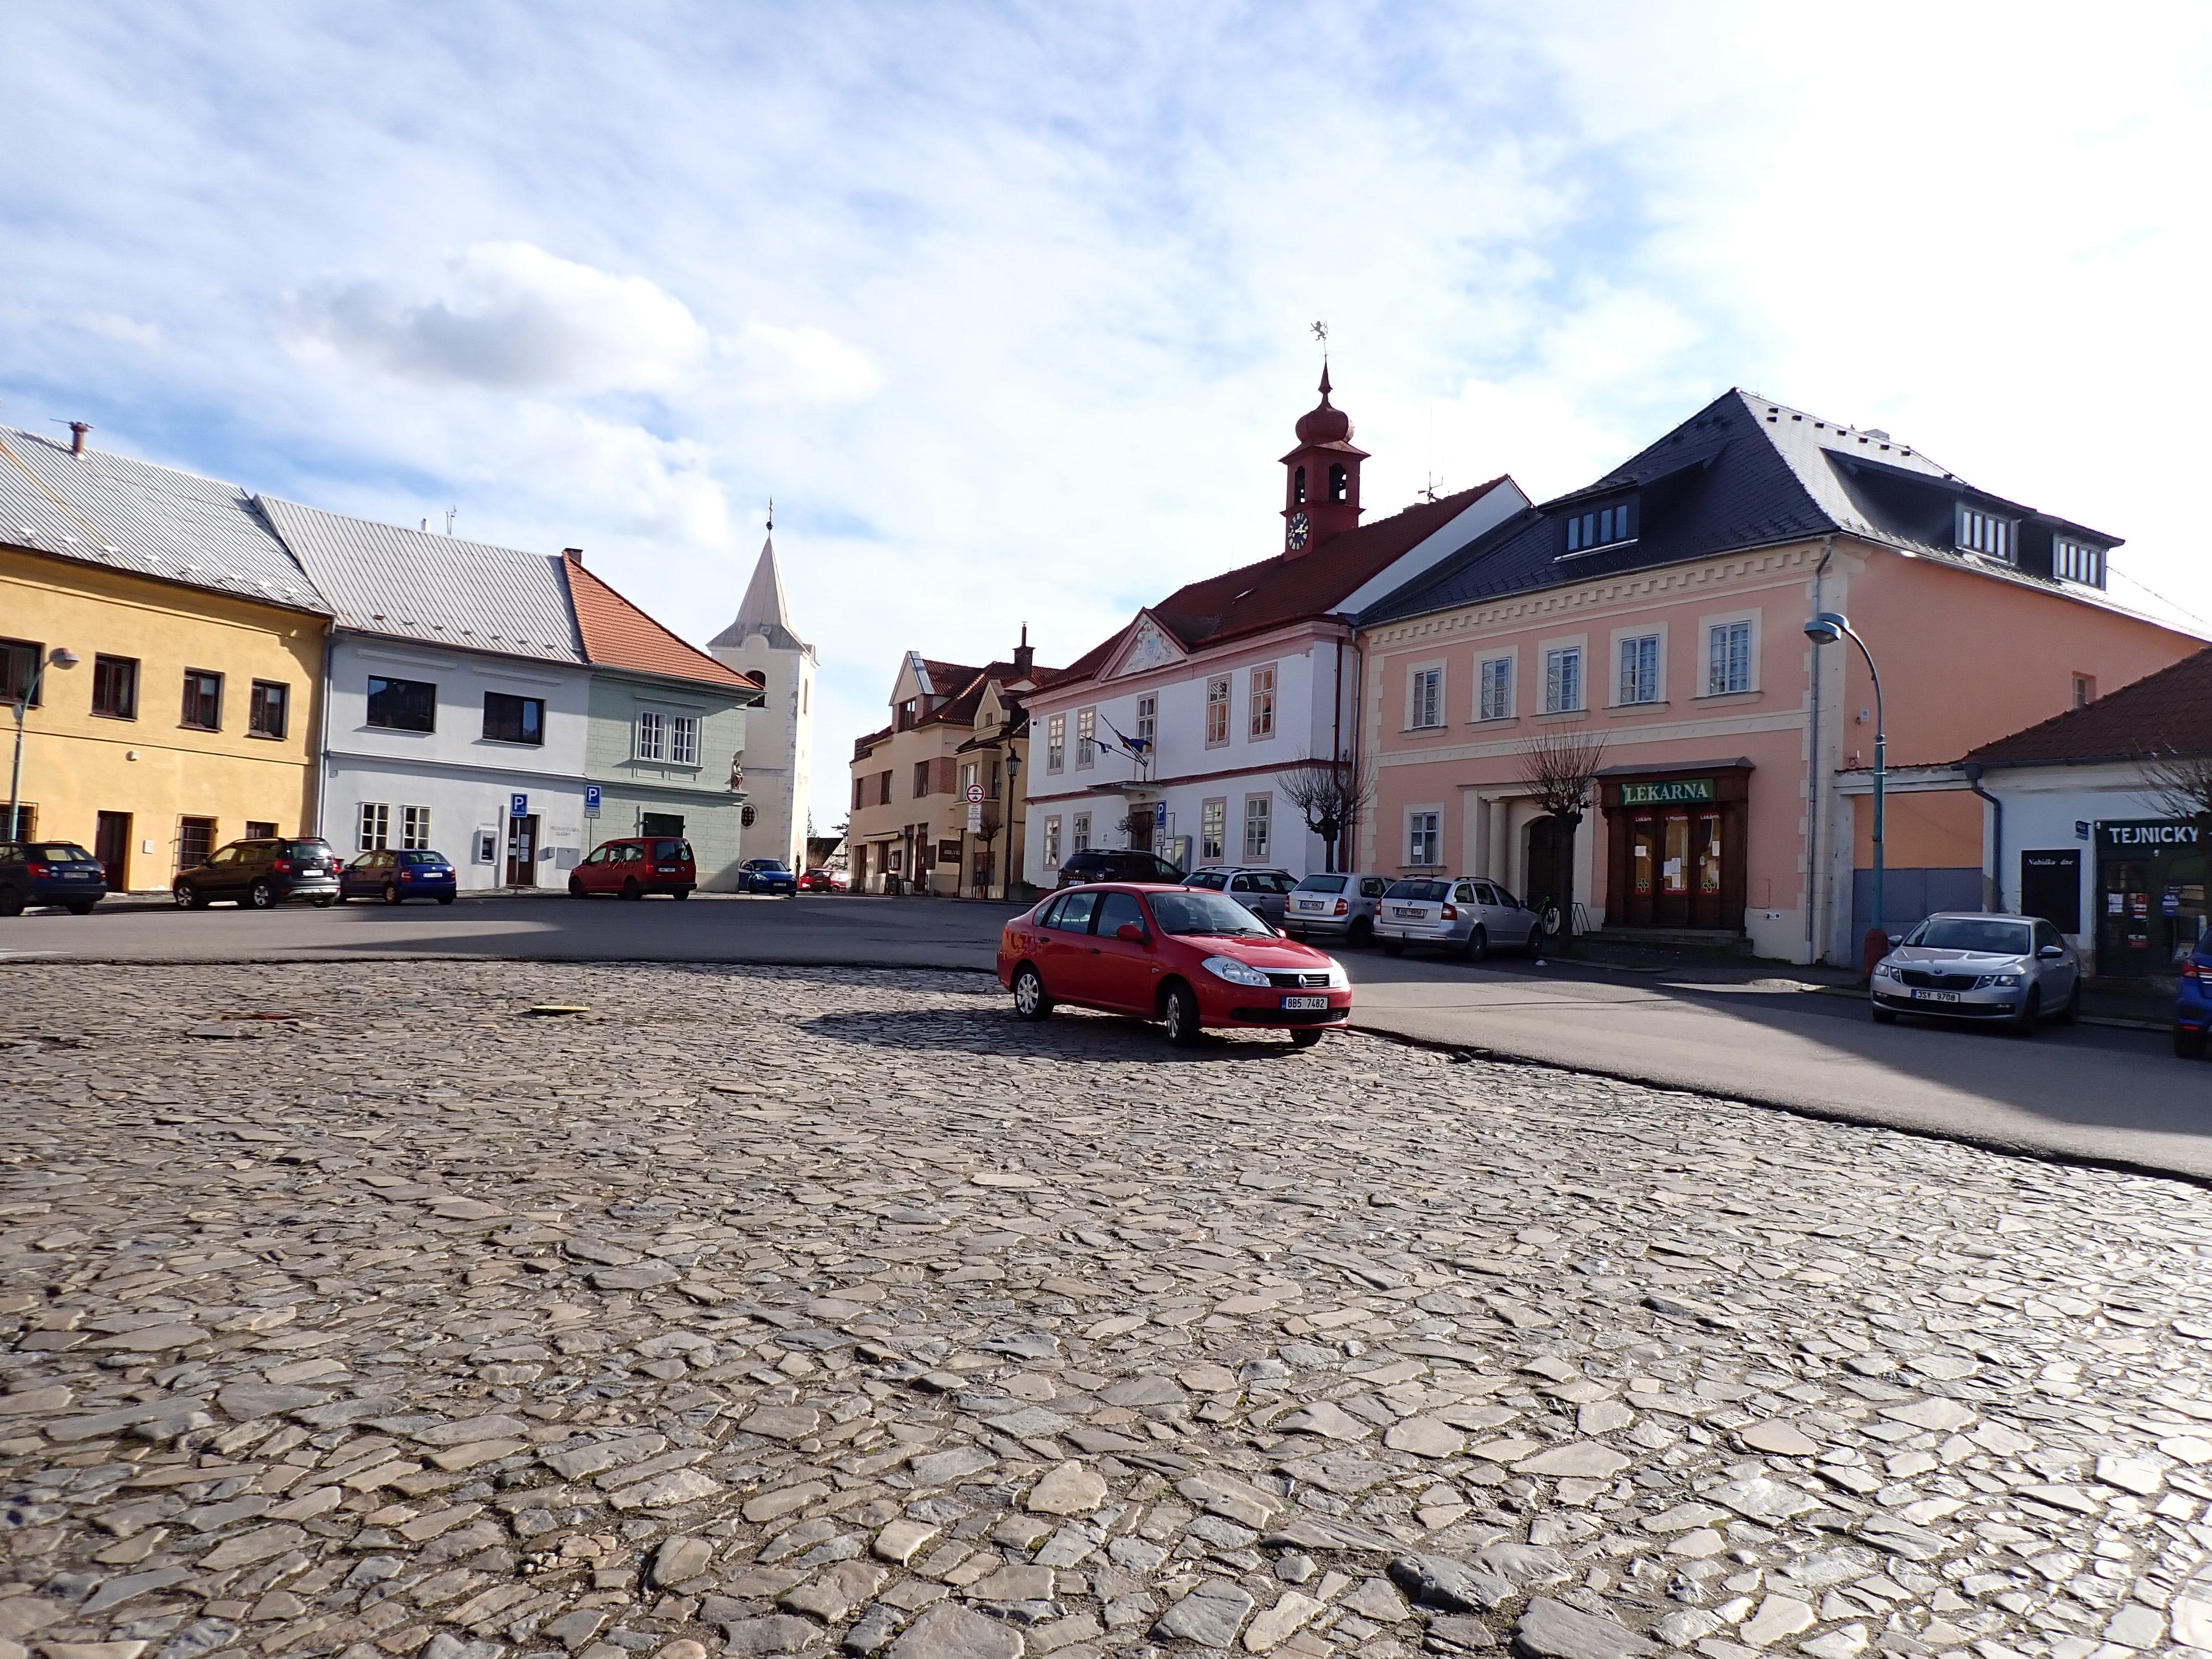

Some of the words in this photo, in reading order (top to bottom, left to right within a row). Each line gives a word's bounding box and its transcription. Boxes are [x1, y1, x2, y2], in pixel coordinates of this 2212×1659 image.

[588, 788, 597, 801] P
[1625, 783, 1709, 802] LÉKÁRNA
[514, 796, 524, 810] P
[1158, 804, 1164, 818] P
[1287, 998, 1302, 1008] 8B5
[1307, 998, 1324, 1008] 7482
[1937, 993, 1955, 1001] 9708
